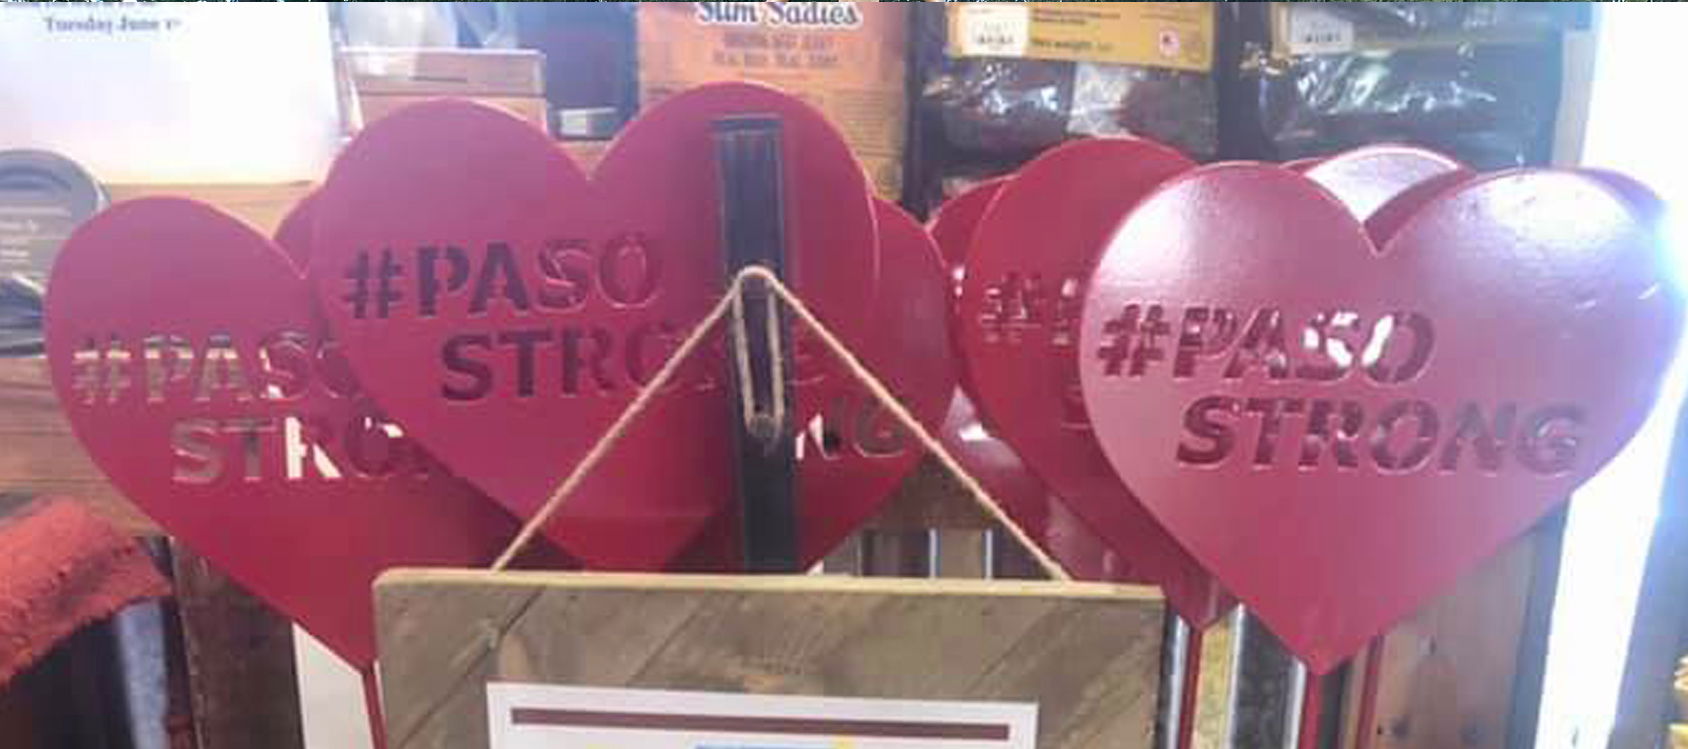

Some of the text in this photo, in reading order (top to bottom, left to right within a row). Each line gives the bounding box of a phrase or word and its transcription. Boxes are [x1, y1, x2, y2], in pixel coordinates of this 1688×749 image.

[43, 14, 113, 35] Tuesday
[117, 14, 159, 32] June
[343, 234, 657, 321] #PASO
[1097, 303, 1435, 385] #PASO
[1175, 395, 1587, 477] STRONG
